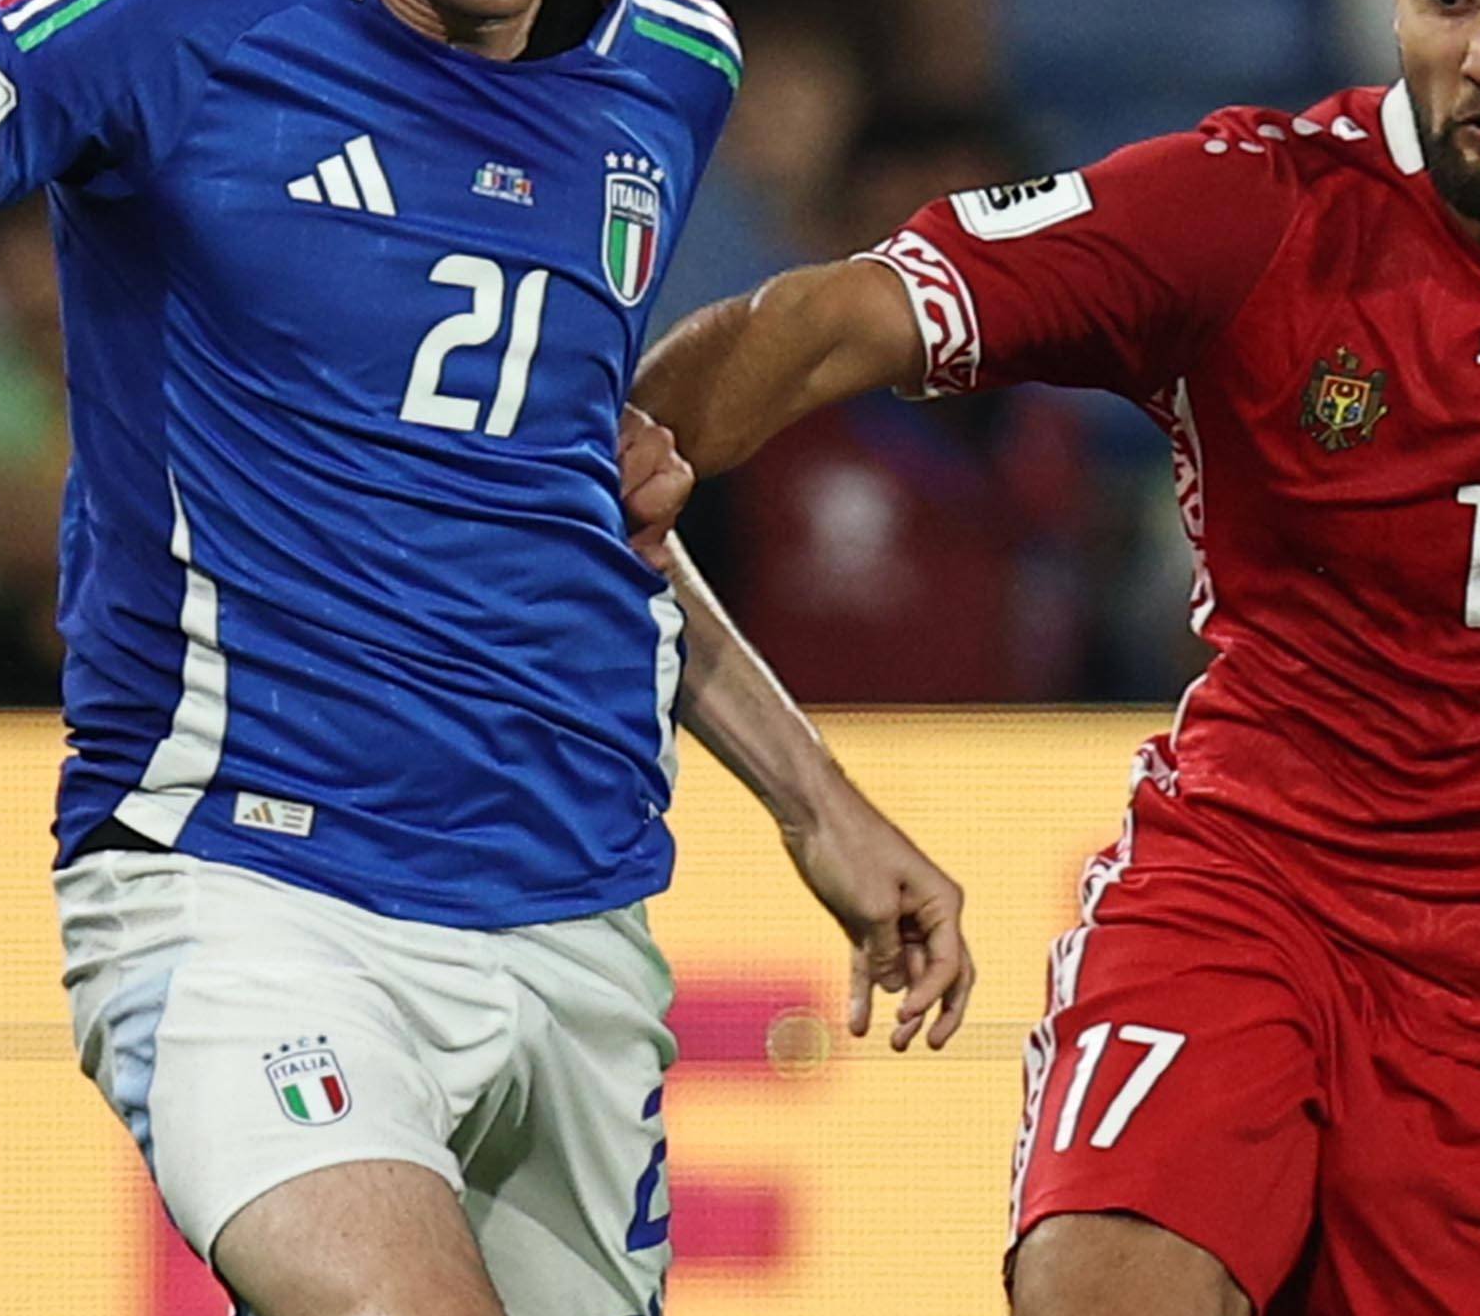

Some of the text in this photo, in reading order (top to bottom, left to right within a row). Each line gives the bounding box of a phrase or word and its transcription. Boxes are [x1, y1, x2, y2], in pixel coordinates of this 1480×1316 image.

[612, 182, 655, 217] ITALIA
[399, 253, 550, 438] 21
[272, 1056, 331, 1081] ITALIA
[1052, 1021, 1186, 1153] 17
